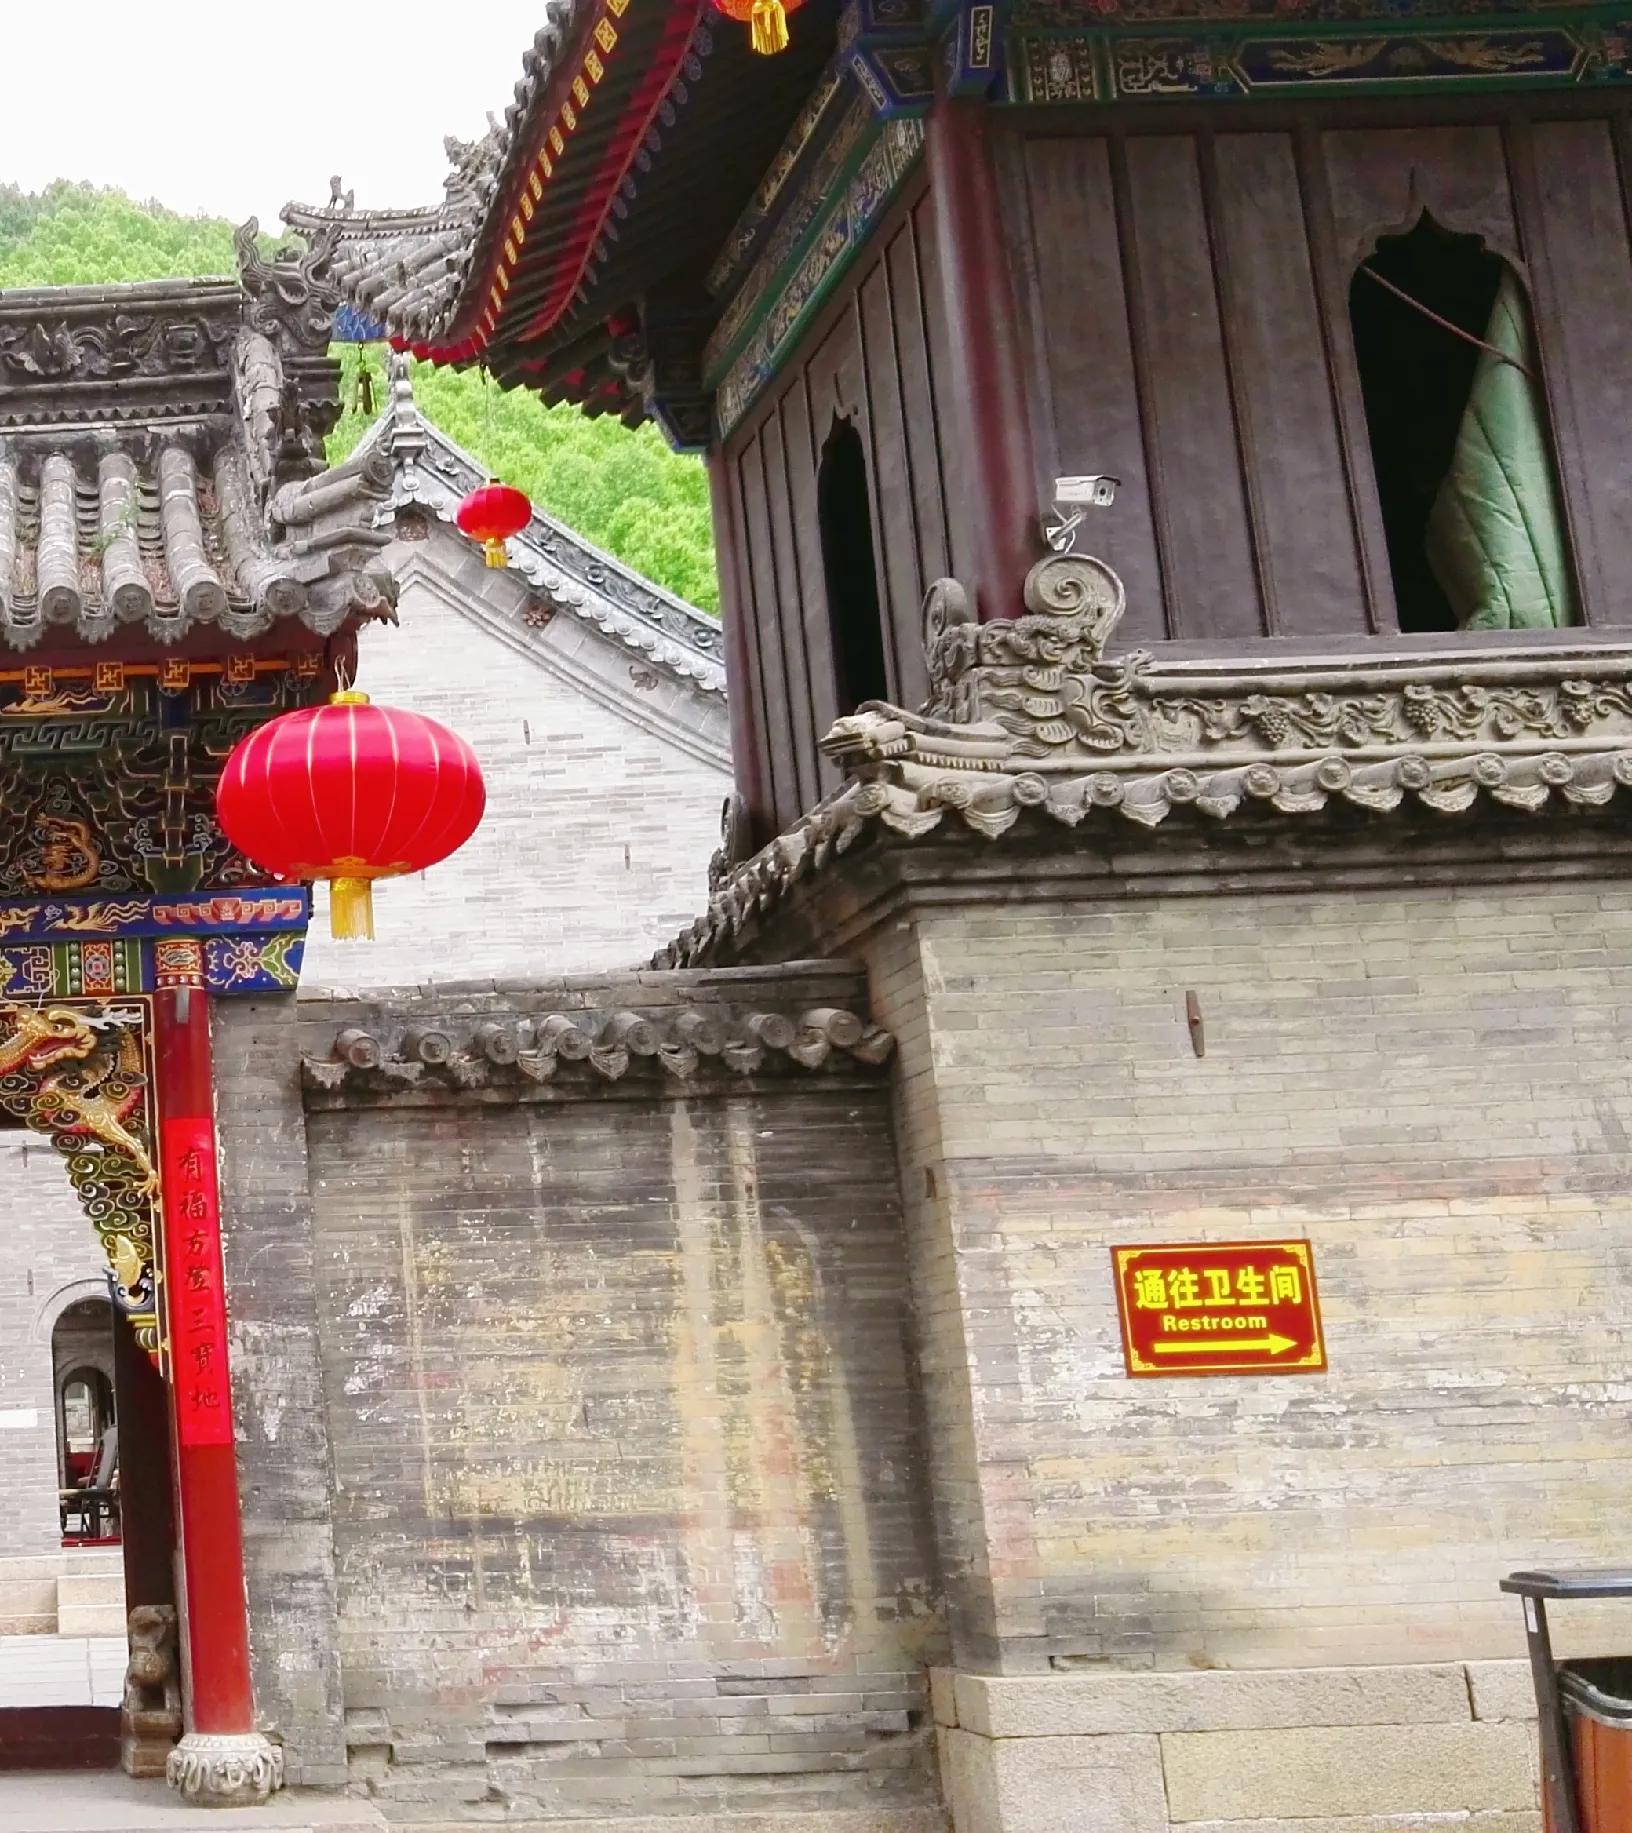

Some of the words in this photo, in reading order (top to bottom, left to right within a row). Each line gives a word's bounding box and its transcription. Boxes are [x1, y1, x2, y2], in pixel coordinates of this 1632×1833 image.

[1133, 1265, 1302, 1309] 通往卫生间
[1163, 1314, 1267, 1332] Restroom
